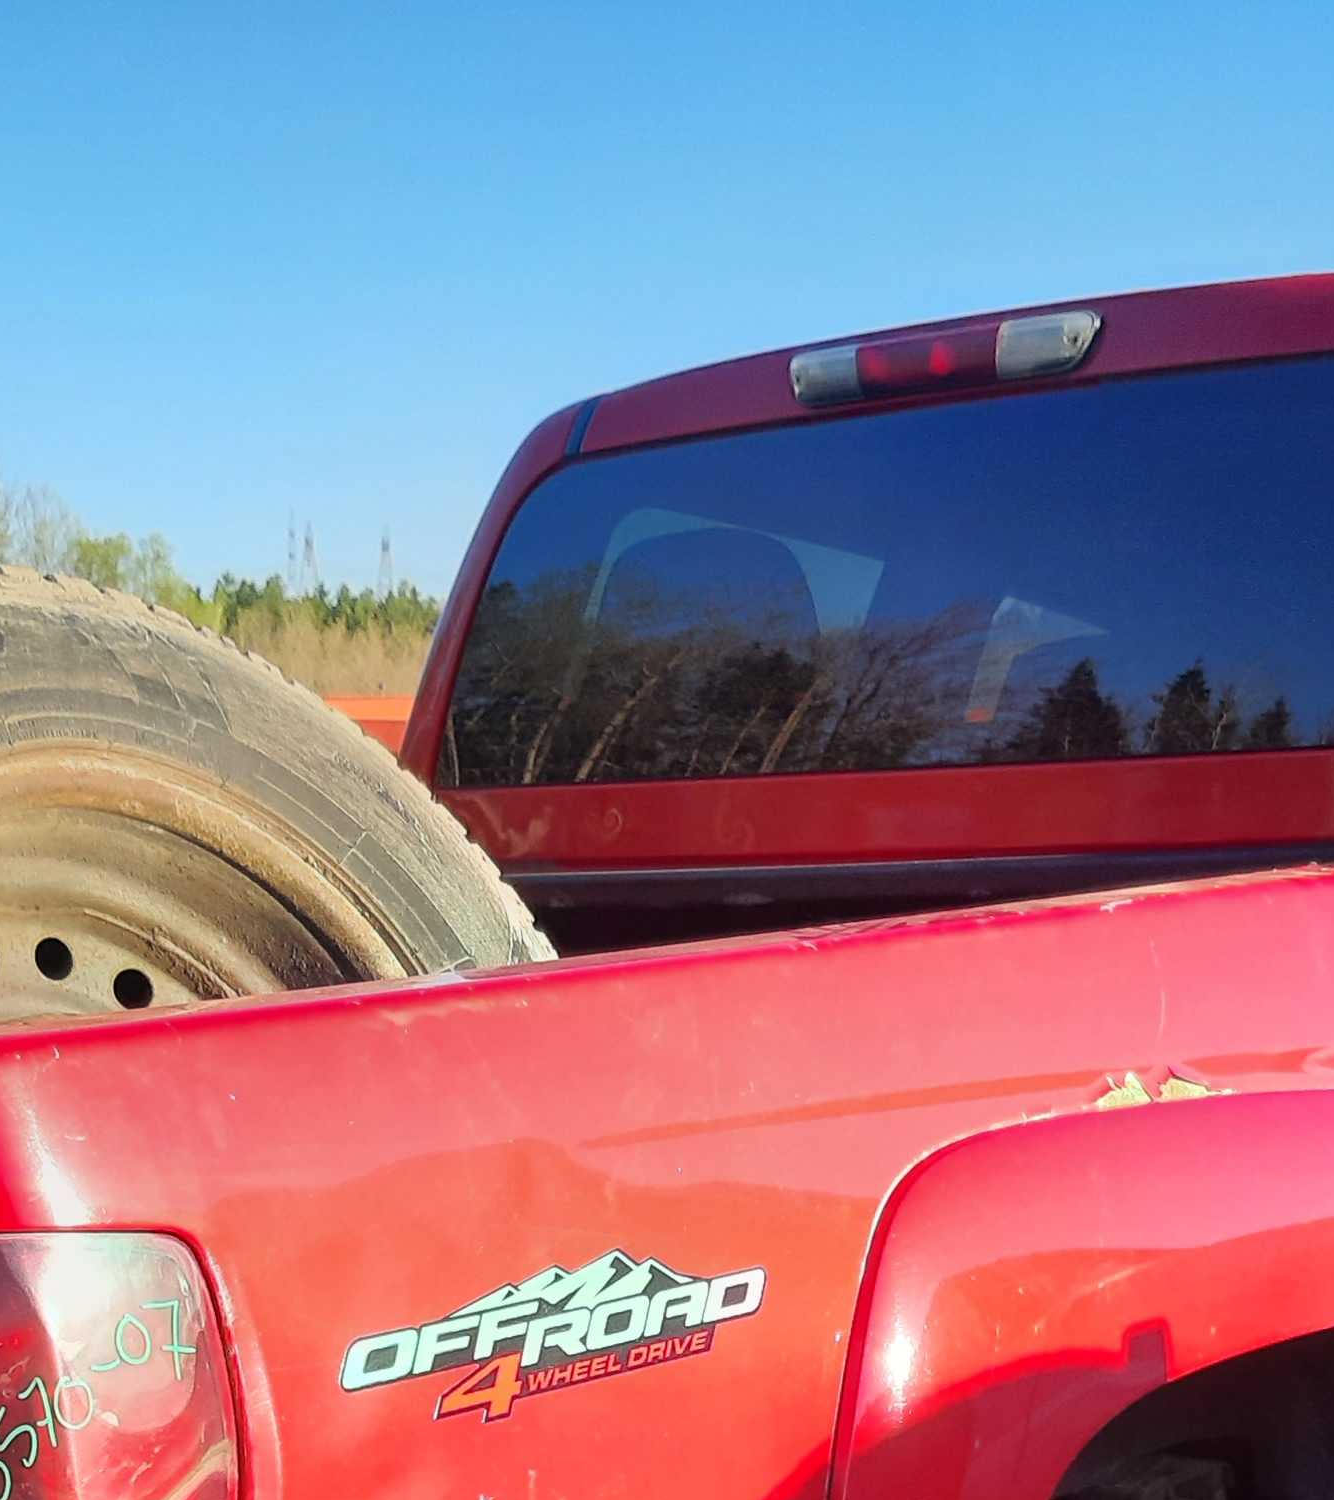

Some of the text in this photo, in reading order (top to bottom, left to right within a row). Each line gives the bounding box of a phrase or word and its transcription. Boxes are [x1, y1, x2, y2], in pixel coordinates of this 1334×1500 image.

[341, 1266, 767, 1392] OFFROAD
[434, 1331, 710, 1423] 4 WHEEL DRIVE
